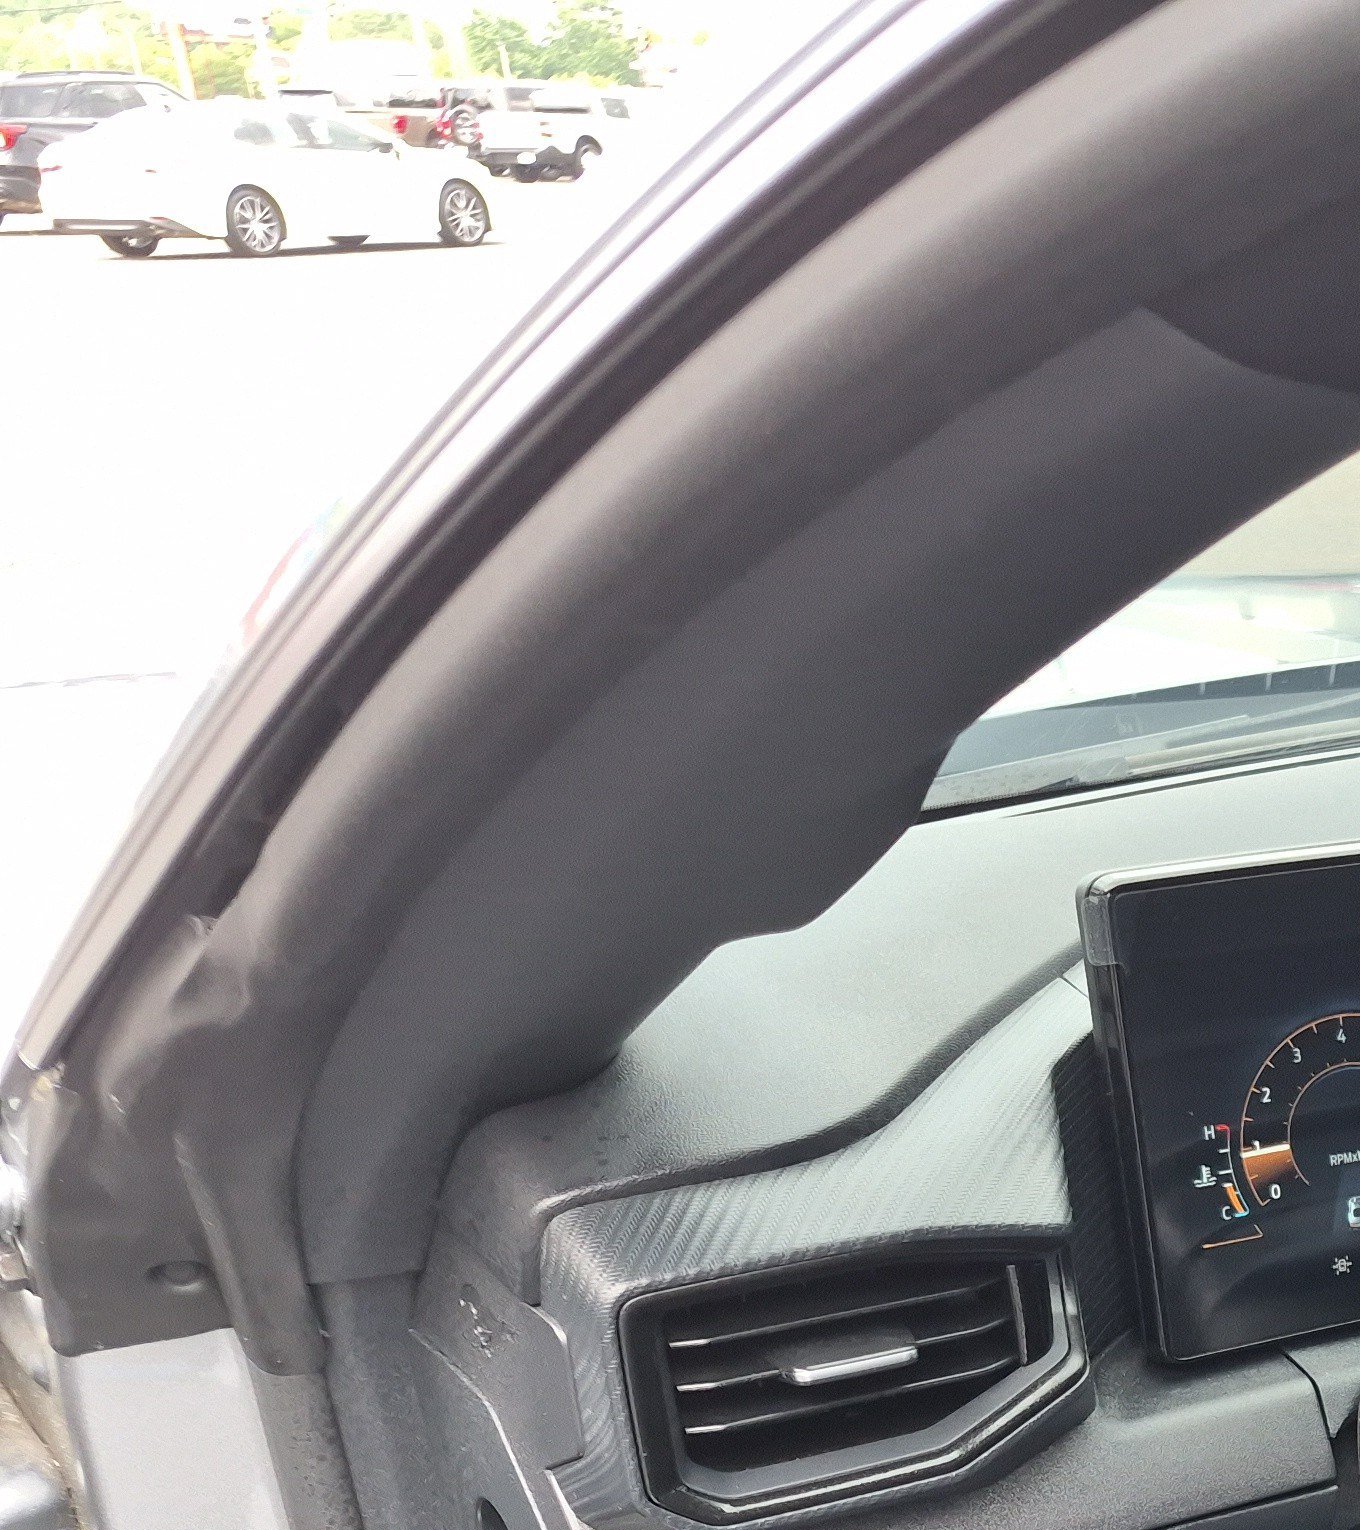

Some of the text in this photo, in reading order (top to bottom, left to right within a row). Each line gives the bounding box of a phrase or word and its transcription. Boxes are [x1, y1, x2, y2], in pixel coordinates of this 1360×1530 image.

[1336, 1028, 1347, 1043] 4
[1292, 1048, 1302, 1063] 3
[1261, 1088, 1271, 1103] 2
[1203, 1125, 1216, 1140] H
[1270, 1183, 1281, 1199] 0
[1221, 1205, 1232, 1220] C
